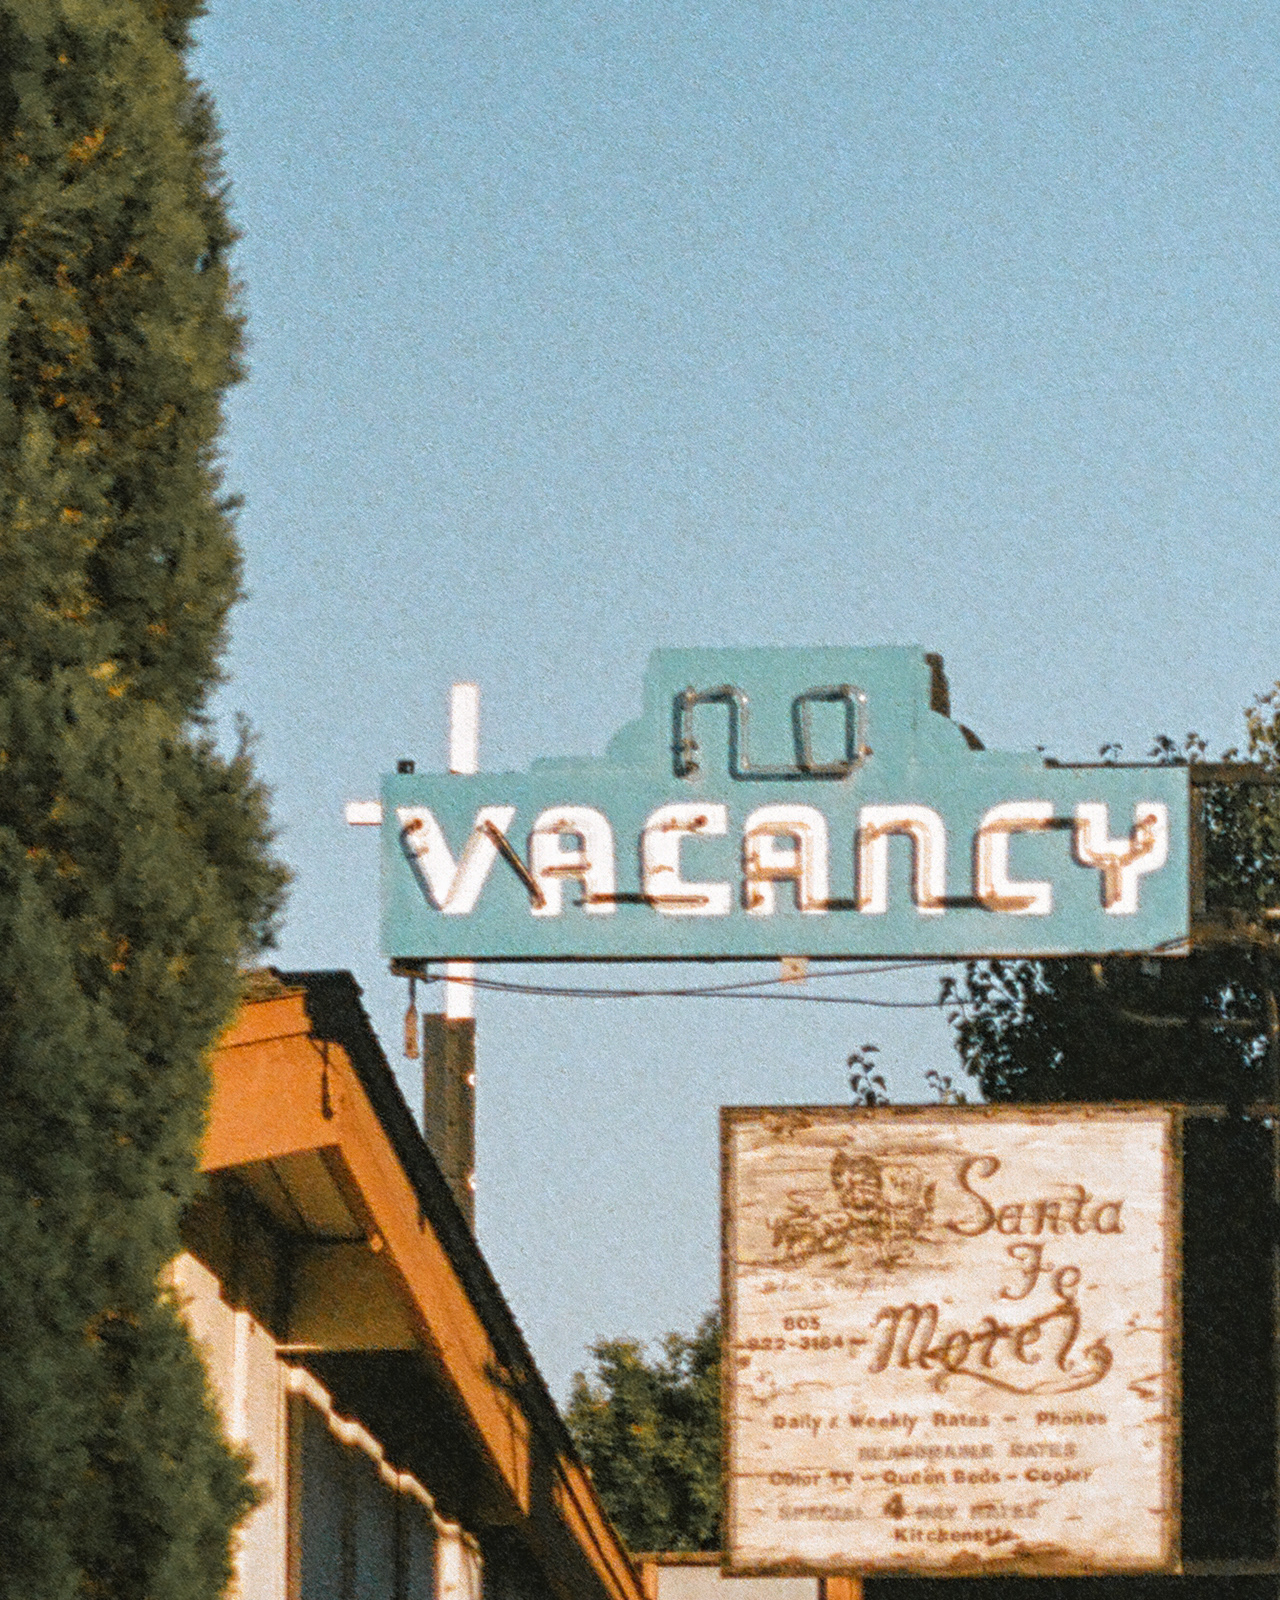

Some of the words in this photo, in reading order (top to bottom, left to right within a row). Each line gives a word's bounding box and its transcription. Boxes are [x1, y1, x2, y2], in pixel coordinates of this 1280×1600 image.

[396, 802, 1168, 916] VACANCY
[945, 1155, 1125, 1237] Santa
[998, 1242, 1082, 1300] Fe
[868, 1300, 1113, 1394] Motel
[772, 1413, 821, 1438] Daily
[849, 1410, 918, 1437] Weekly
[933, 1411, 991, 1427] Rates
[1036, 1410, 1107, 1426] Phones
[882, 1469, 947, 1486] Queen
[883, 1491, 907, 1521] 4
